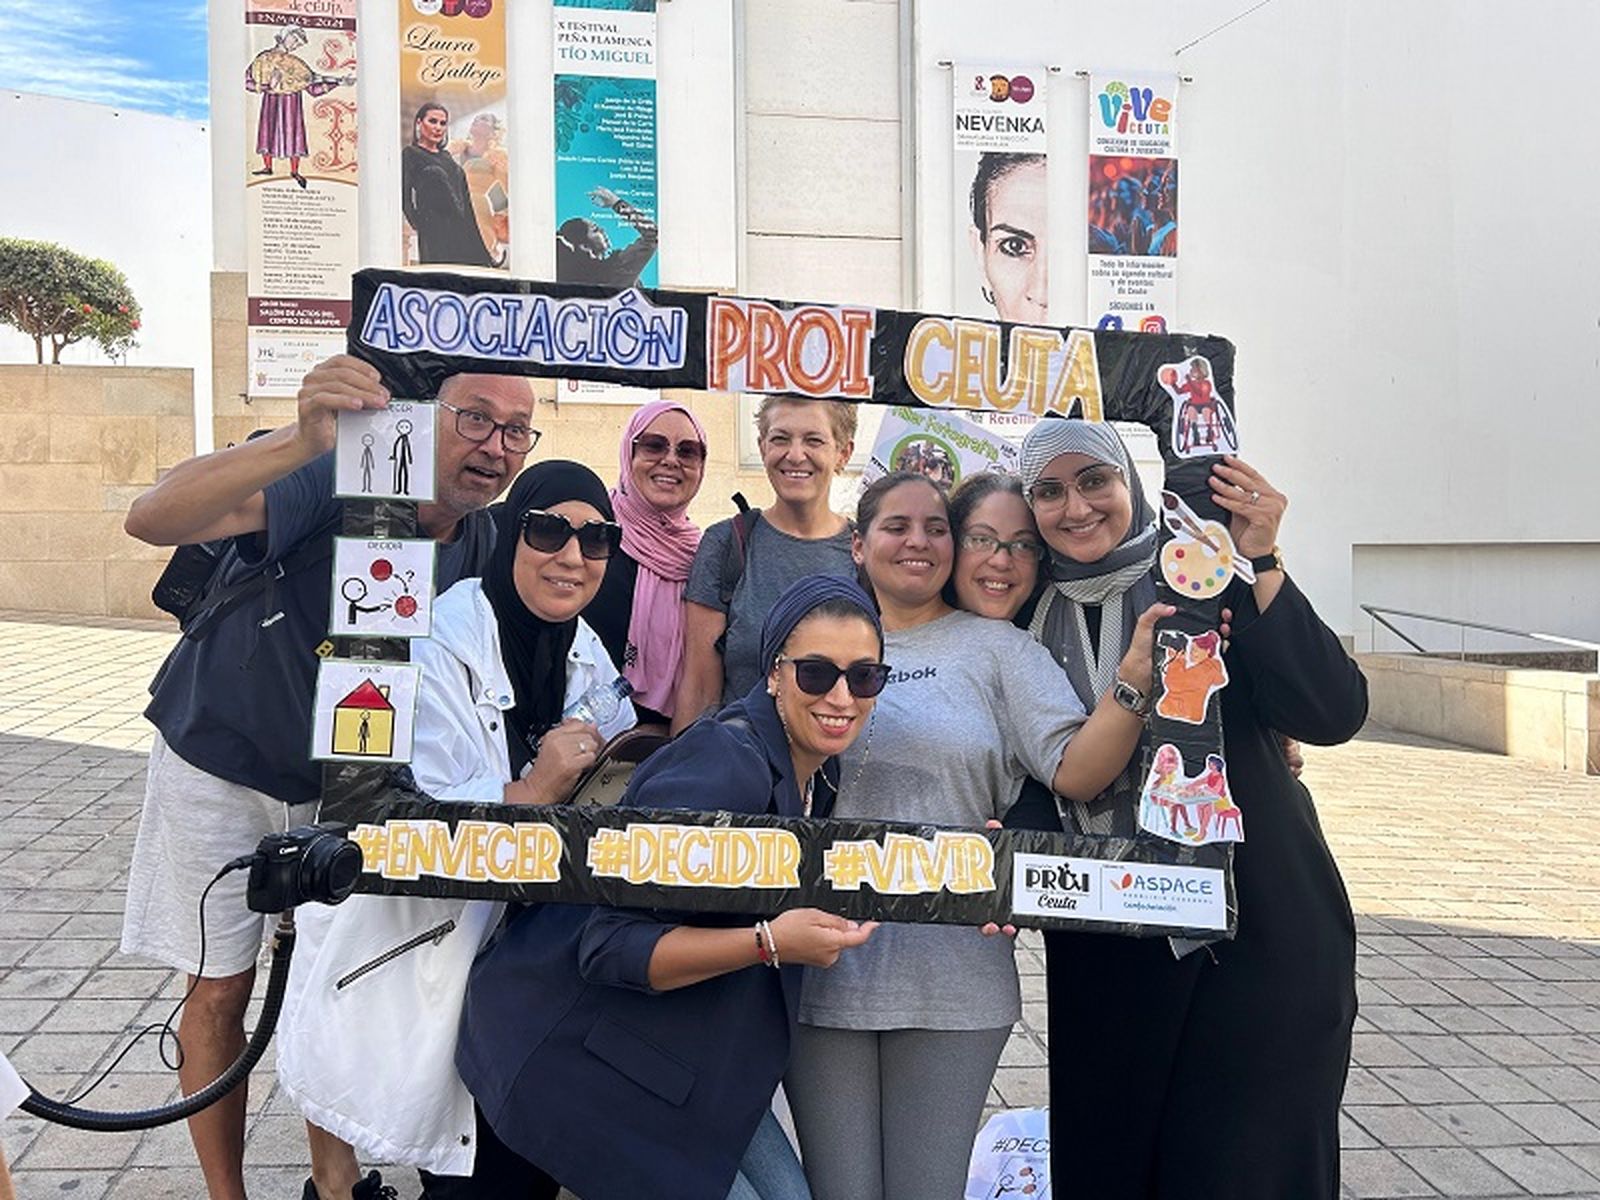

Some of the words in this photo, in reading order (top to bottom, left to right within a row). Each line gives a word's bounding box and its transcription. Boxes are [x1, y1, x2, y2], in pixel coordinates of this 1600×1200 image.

[568, 22, 618, 33] FESTIVAL
[404, 26, 476, 52] Laura
[558, 32, 588, 43] PEÑA
[591, 36, 652, 47] FLAMENCA
[558, 46, 587, 60] TÍO
[591, 50, 653, 64] MIGUEL
[421, 54, 501, 89] Gallego
[956, 114, 1044, 133] NEVENKA
[1129, 122, 1168, 134] CEUTA
[362, 287, 684, 366] ASOCIACIÓN
[710, 300, 872, 396] PROI
[904, 318, 1101, 422] CEUTA
[355, 822, 558, 880] #ENVECER
[591, 826, 800, 885] #DECIDIR
[827, 836, 993, 892] #VIVIR
[1134, 875, 1212, 894] ASPACE
[1038, 894, 1077, 910] Ceuta
[992, 1138, 1049, 1152] #DEC
